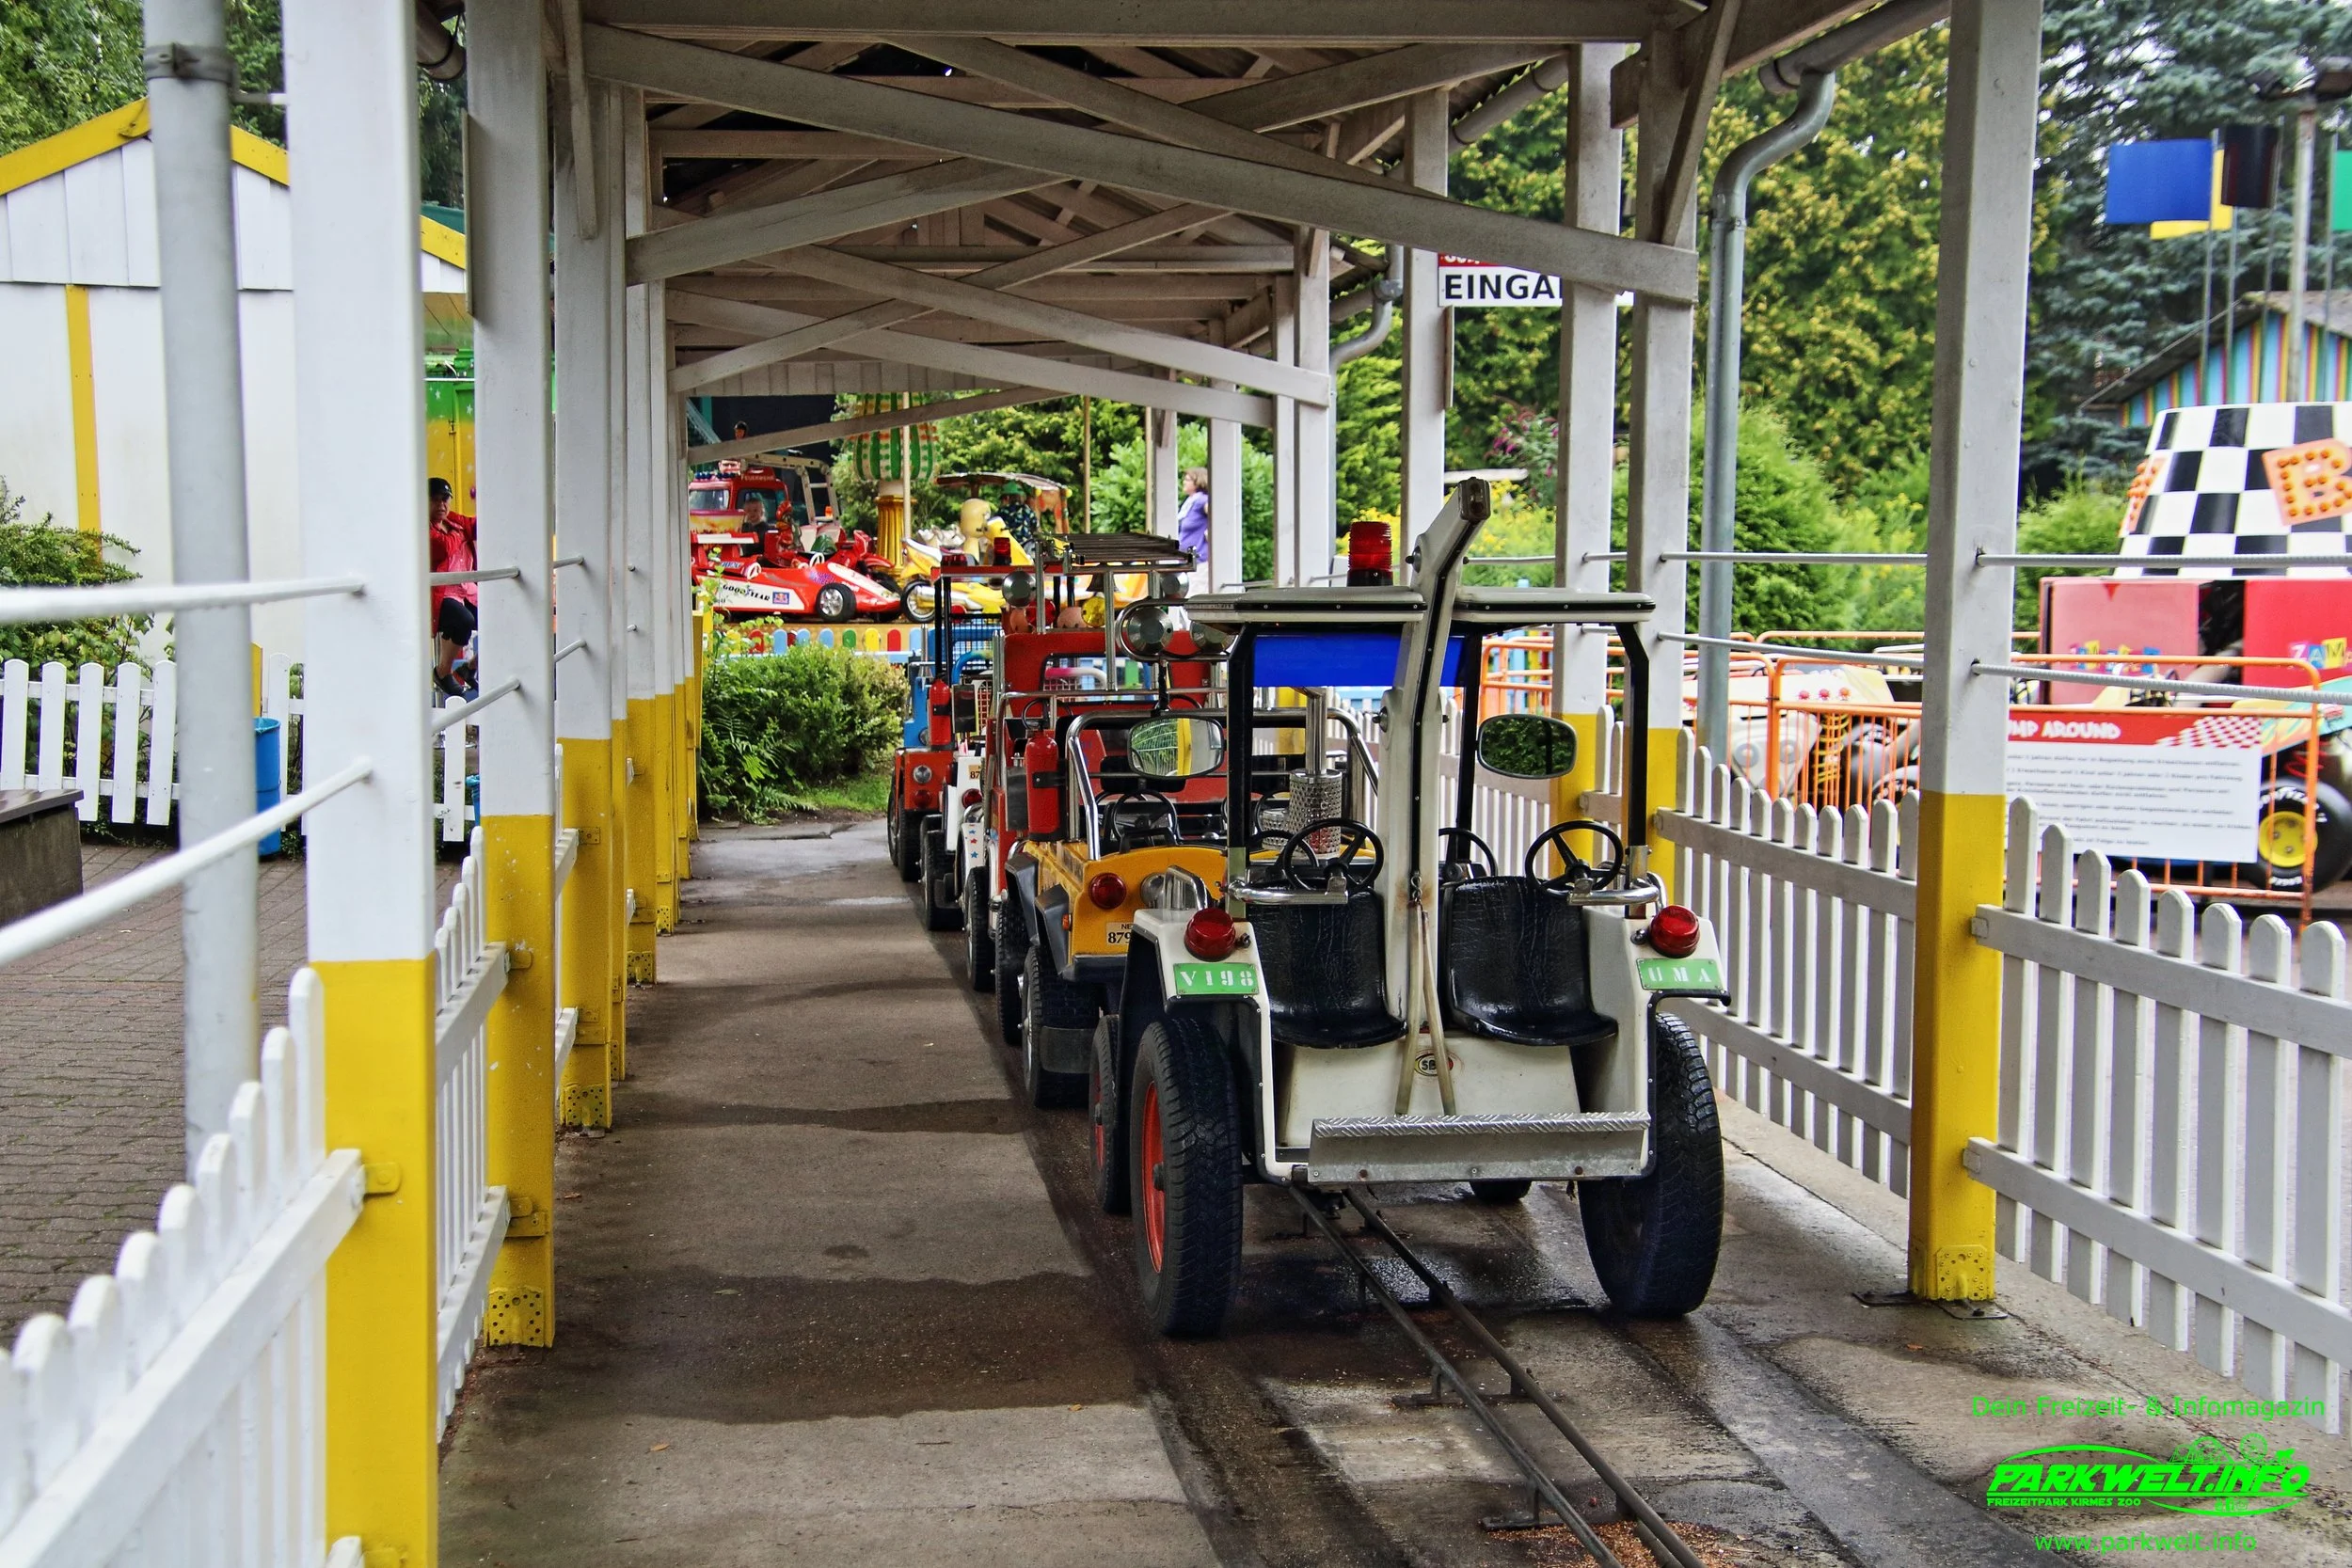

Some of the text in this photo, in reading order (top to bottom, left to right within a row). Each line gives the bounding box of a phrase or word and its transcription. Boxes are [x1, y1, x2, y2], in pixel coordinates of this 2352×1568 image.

[1445, 274, 1563, 299] EINGA
[2041, 720, 2122, 740] AROUND
[1107, 931, 1132, 944] 879
[1421, 1059, 1438, 1070] SB
